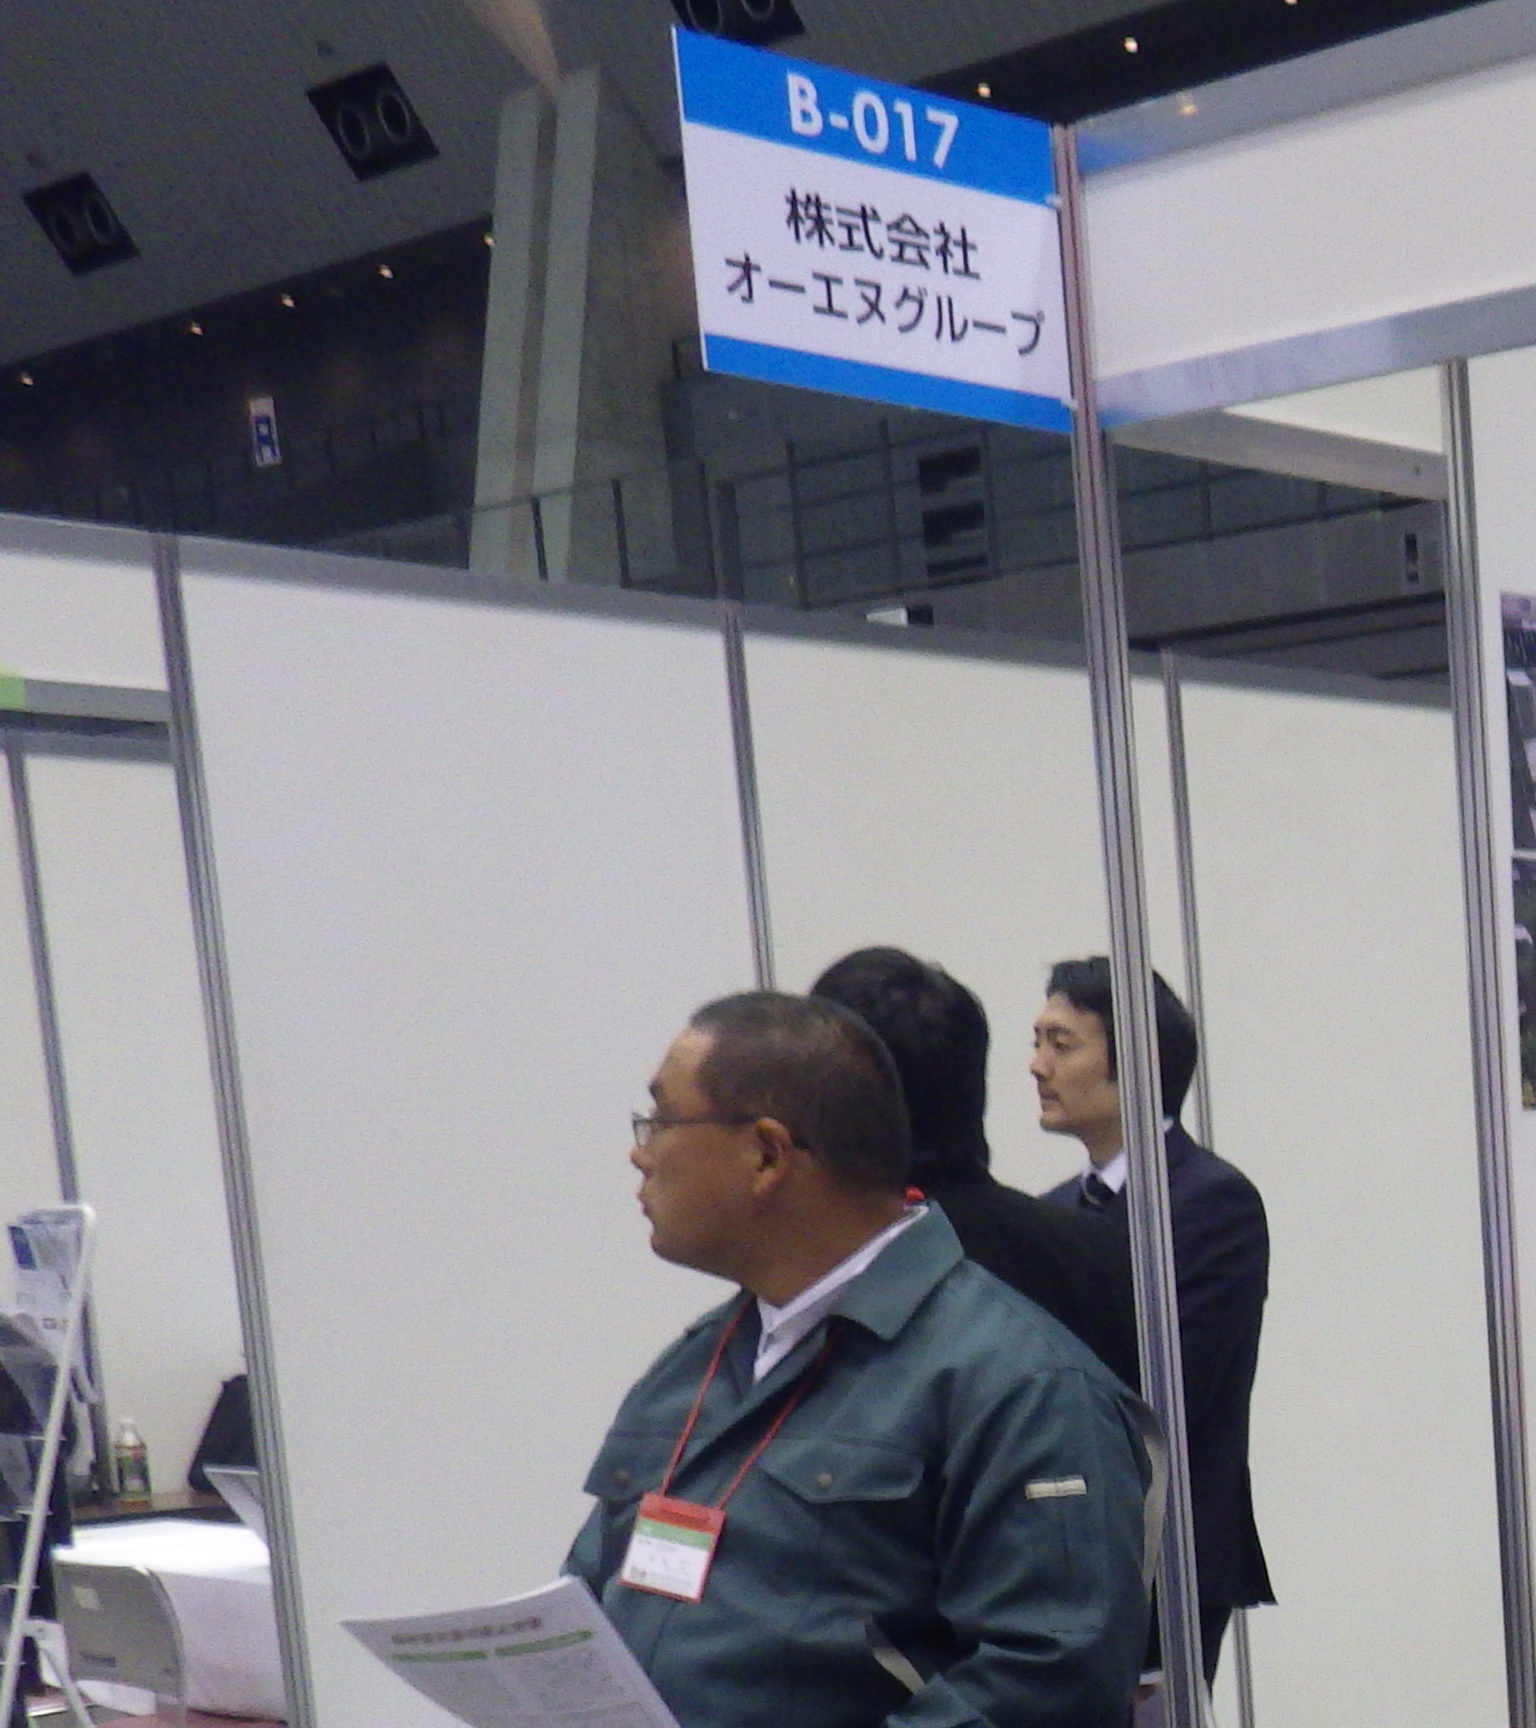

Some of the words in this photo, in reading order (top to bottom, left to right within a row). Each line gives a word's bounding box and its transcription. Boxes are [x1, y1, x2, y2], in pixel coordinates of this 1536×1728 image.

[786, 70, 960, 168] B-017
[786, 188, 980, 281] 株式会社
[725, 253, 1045, 356] オーエヌグループ
